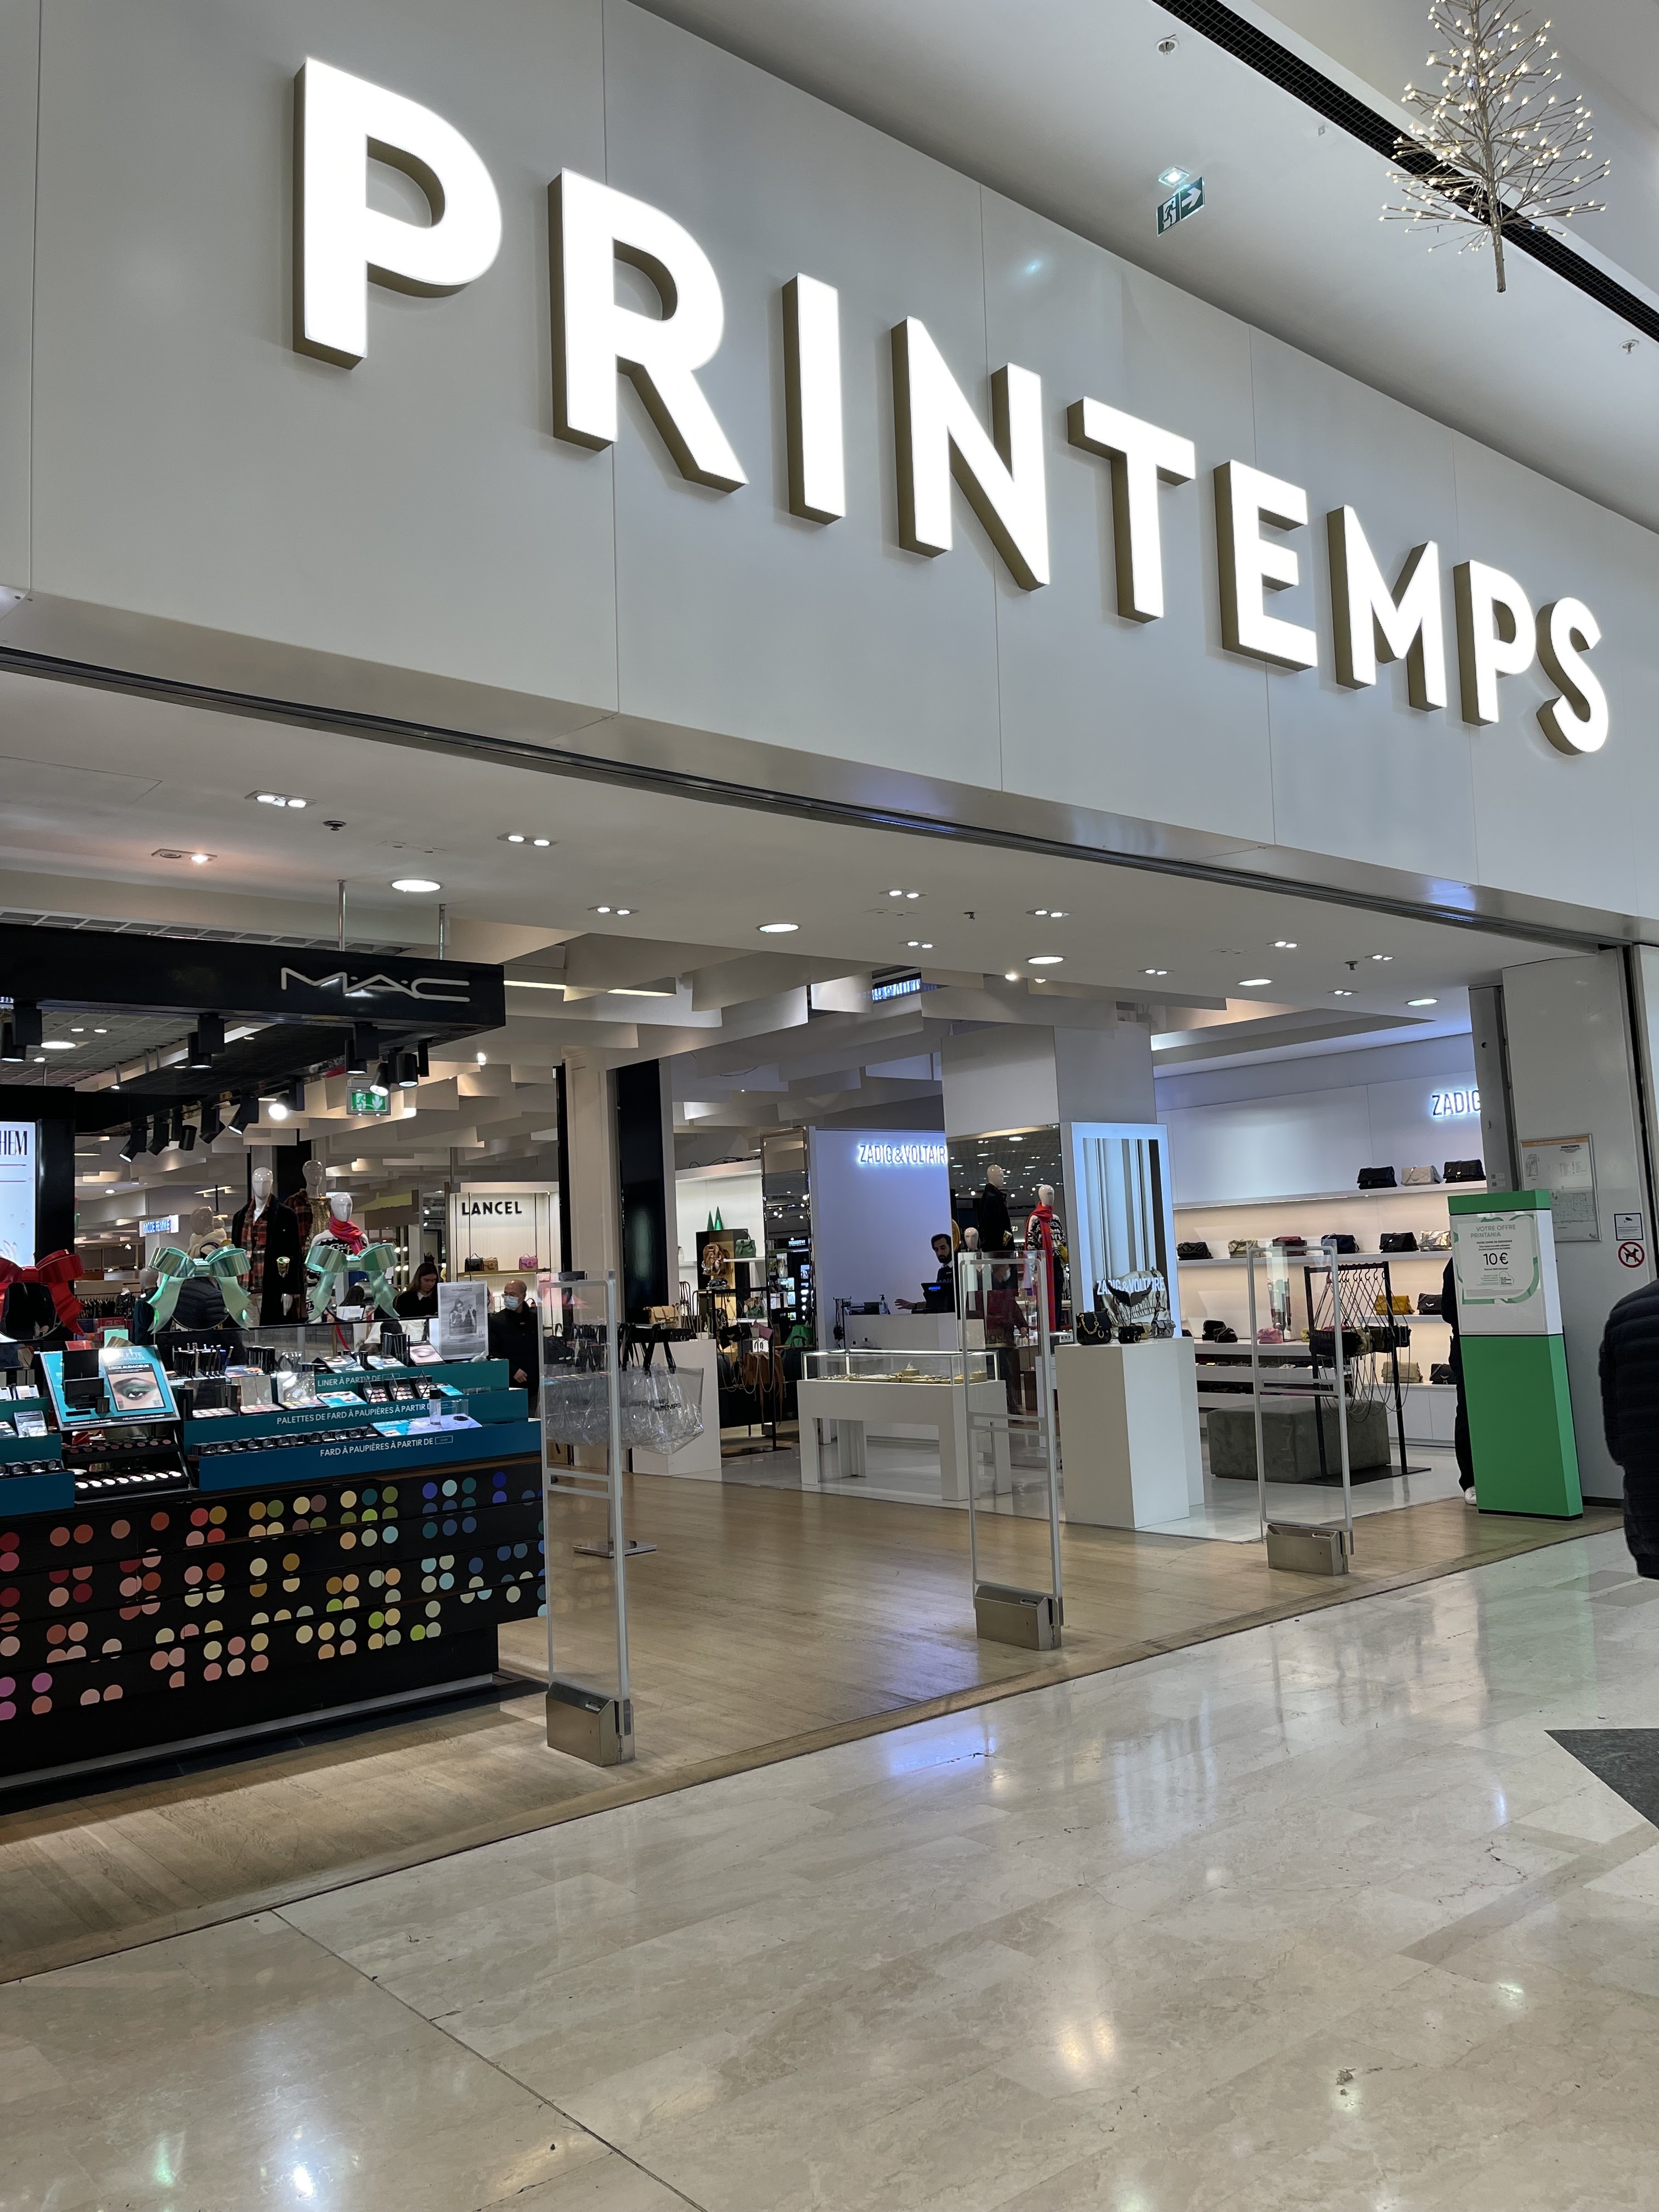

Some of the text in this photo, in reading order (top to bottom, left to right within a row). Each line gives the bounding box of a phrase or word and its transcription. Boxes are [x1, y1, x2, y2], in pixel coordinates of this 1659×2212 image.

[295, 57, 1609, 756] PRINTEMPS
[860, 1145, 947, 1163] ZADIG&VOLTAIR
[462, 1201, 522, 1215] LANCEL
[317, 1377, 339, 1387] LINER
[339, 1375, 345, 1386] À
[346, 1375, 370, 1384] PARTIR
[276, 1415, 314, 1425] PALETTES
[315, 1413, 326, 1421] DE
[327, 1410, 347, 1420] FARD
[348, 1408, 354, 1418] À
[356, 1404, 394, 1417] PAUPIÈRES
[394, 1403, 401, 1413] À
[401, 1403, 426, 1412] PARTIR
[320, 1448, 341, 1457] FARD
[342, 1444, 348, 1454] À
[349, 1441, 390, 1454] PAUPIÈRES
[390, 1440, 397, 1449] À
[397, 1438, 423, 1448] PARTIR
